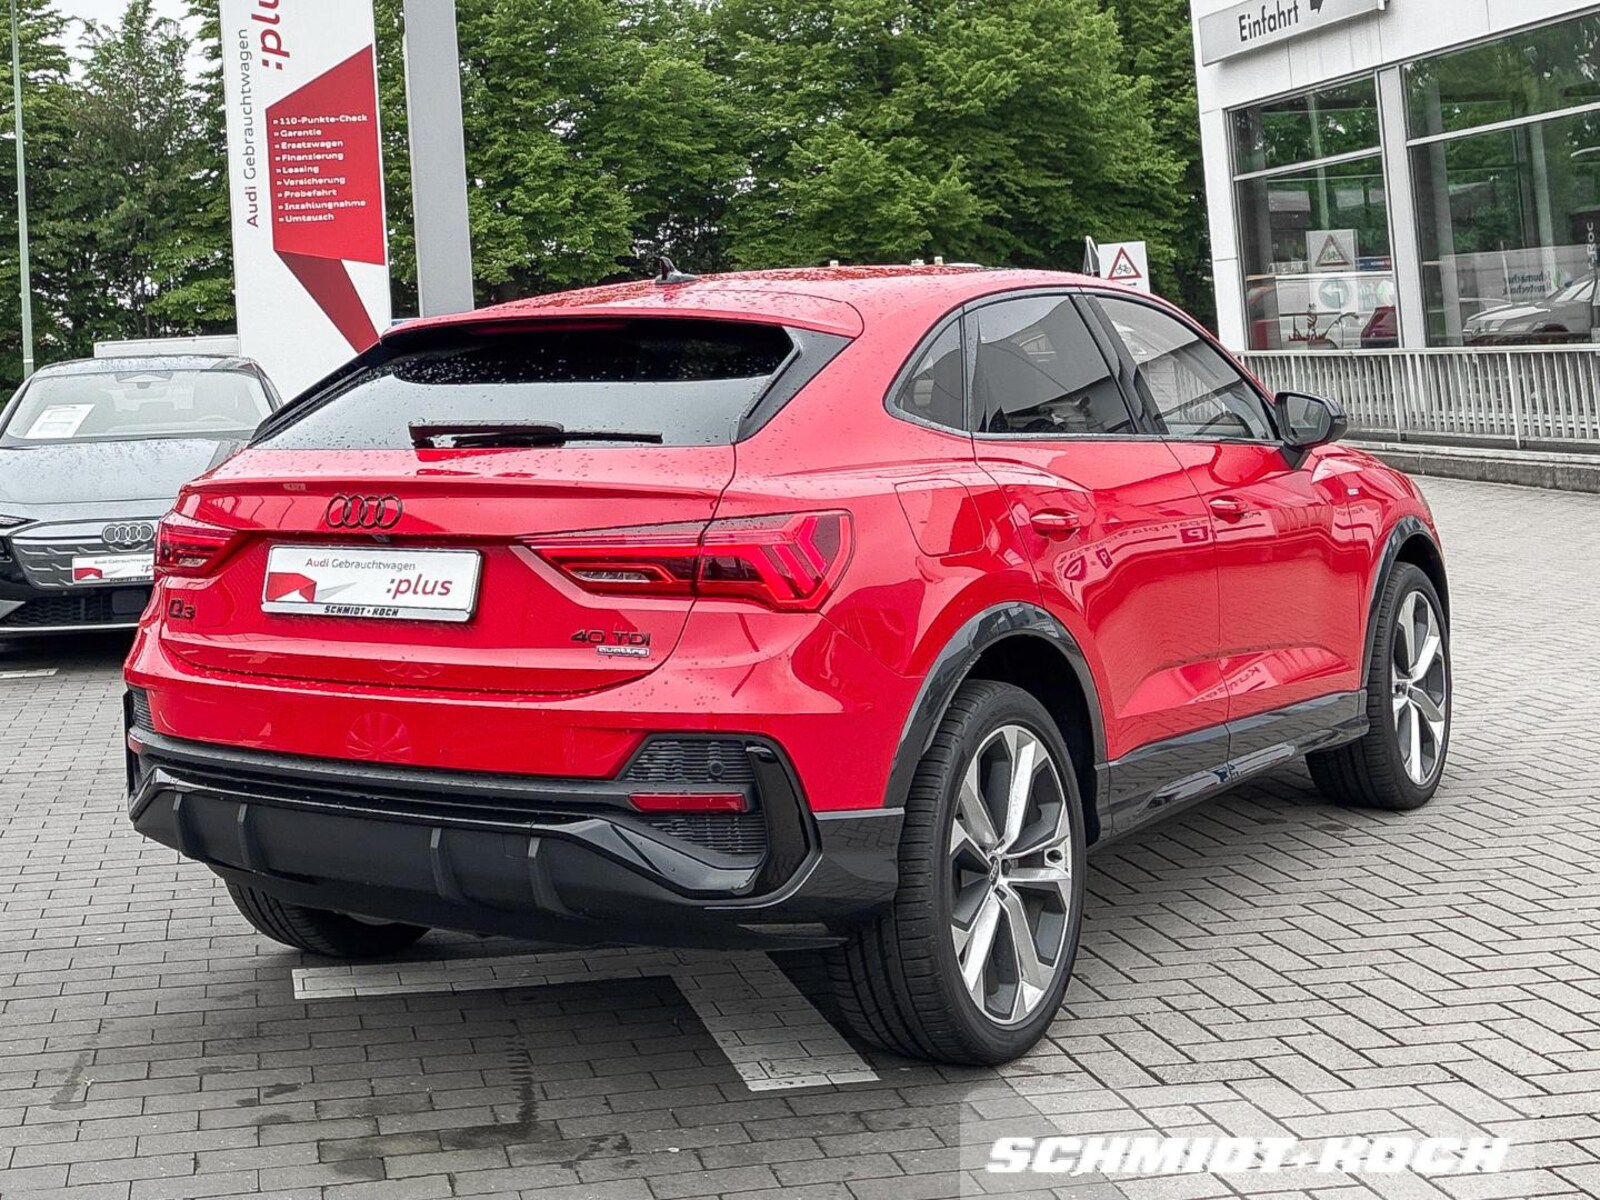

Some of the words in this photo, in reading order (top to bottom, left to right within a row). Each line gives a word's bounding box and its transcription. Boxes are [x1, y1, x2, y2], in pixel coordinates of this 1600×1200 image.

[1238, 0, 1299, 42] Einfahrt
[238, 29, 256, 180] Gebrauchtwagen
[280, 114, 368, 125] 110-Punkte-Check
[280, 129, 322, 137] Garantie
[281, 140, 344, 149] Ersatzwagen
[281, 153, 344, 161] Finanzierung
[282, 165, 319, 174] Leasing
[283, 177, 346, 186] Versicherung
[284, 189, 337, 198] Probefahrt
[245, 186, 258, 228] Audi
[284, 200, 366, 211] Inzahlungnahme
[285, 213, 334, 222] Umtausch
[305, 558, 329, 568] Audi
[331, 558, 416, 572] Gebrauchtwagen
[386, 574, 453, 599] :plus
[169, 599, 196, 620] Q3
[571, 629, 605, 644] 40
[613, 631, 651, 646] TDI
[598, 646, 648, 656] quattro
